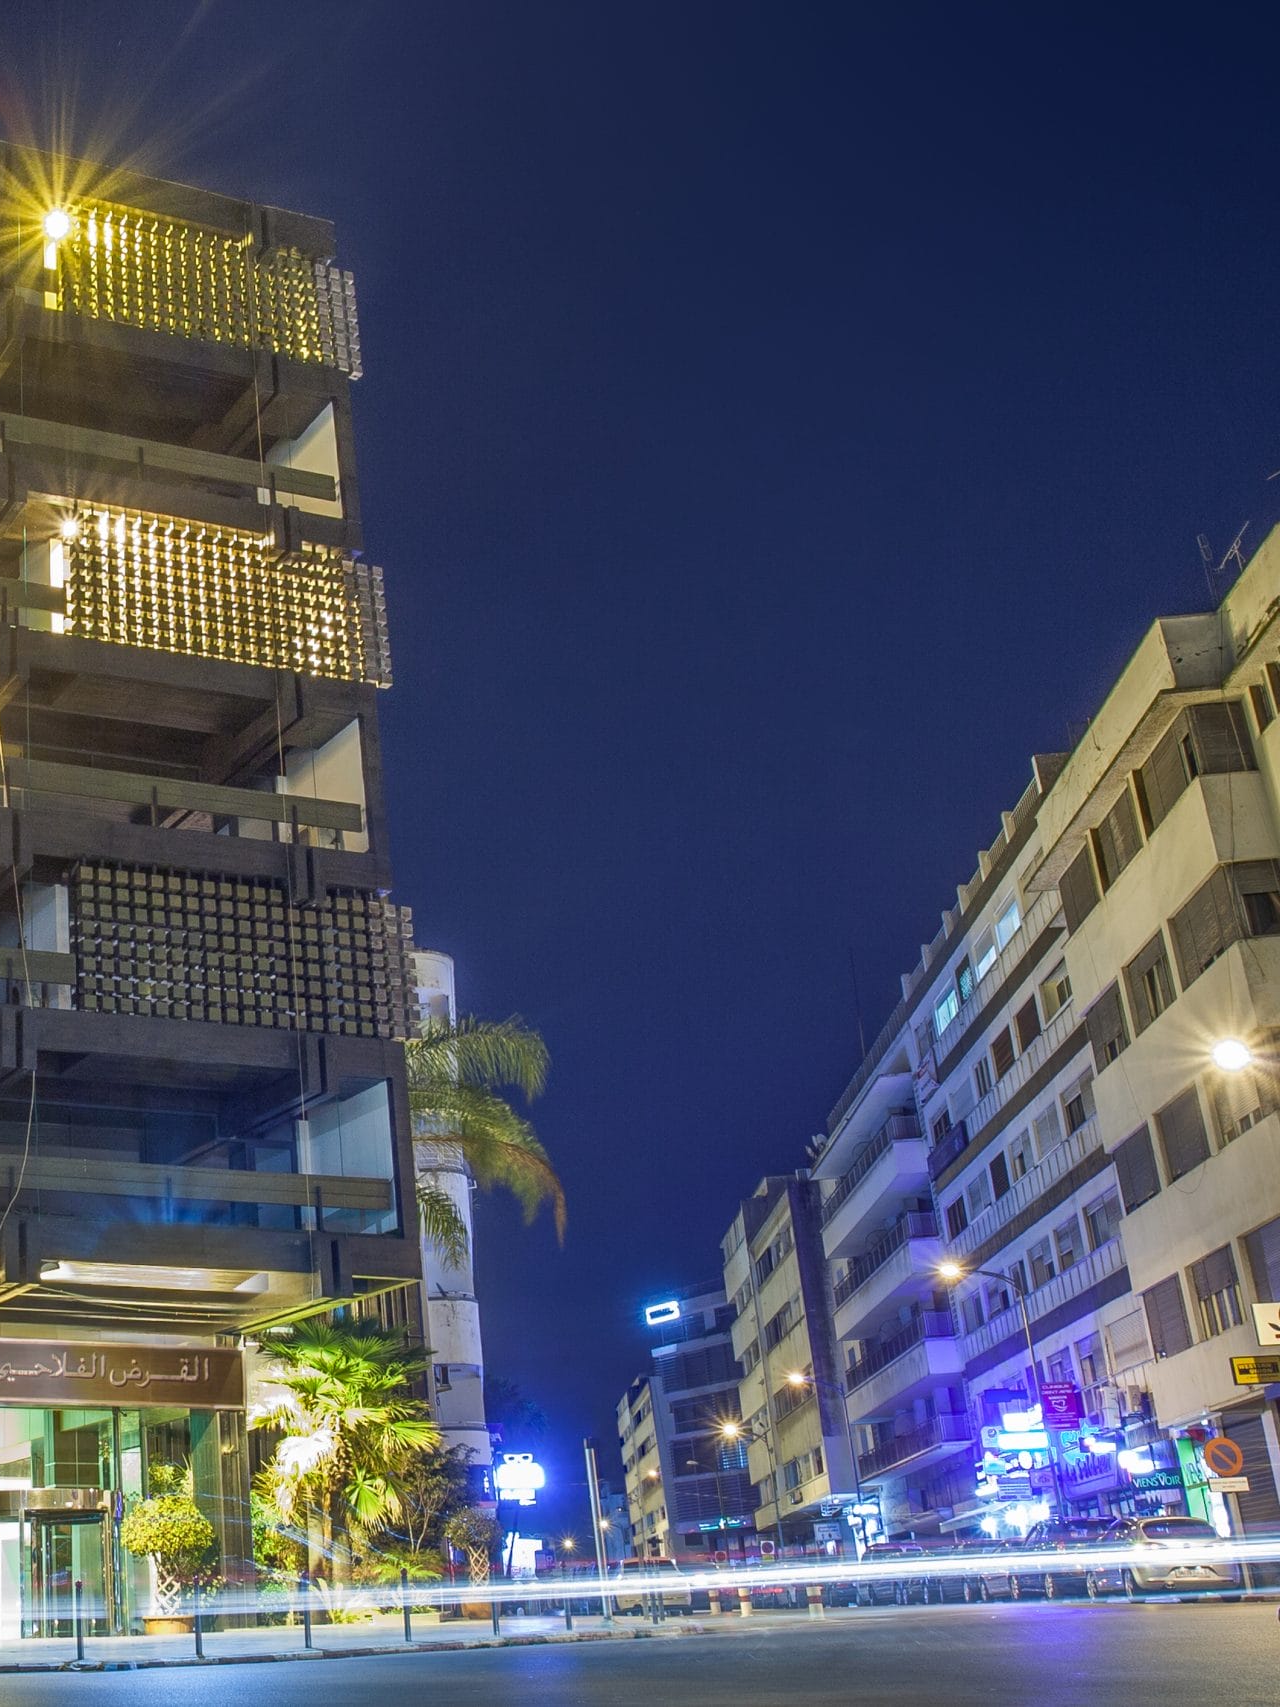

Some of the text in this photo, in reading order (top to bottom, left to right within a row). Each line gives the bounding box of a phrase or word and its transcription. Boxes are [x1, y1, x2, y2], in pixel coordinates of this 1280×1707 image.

[109, 1354, 210, 1387] القرض
[1132, 1472, 1182, 1488] VIENS VOIR
